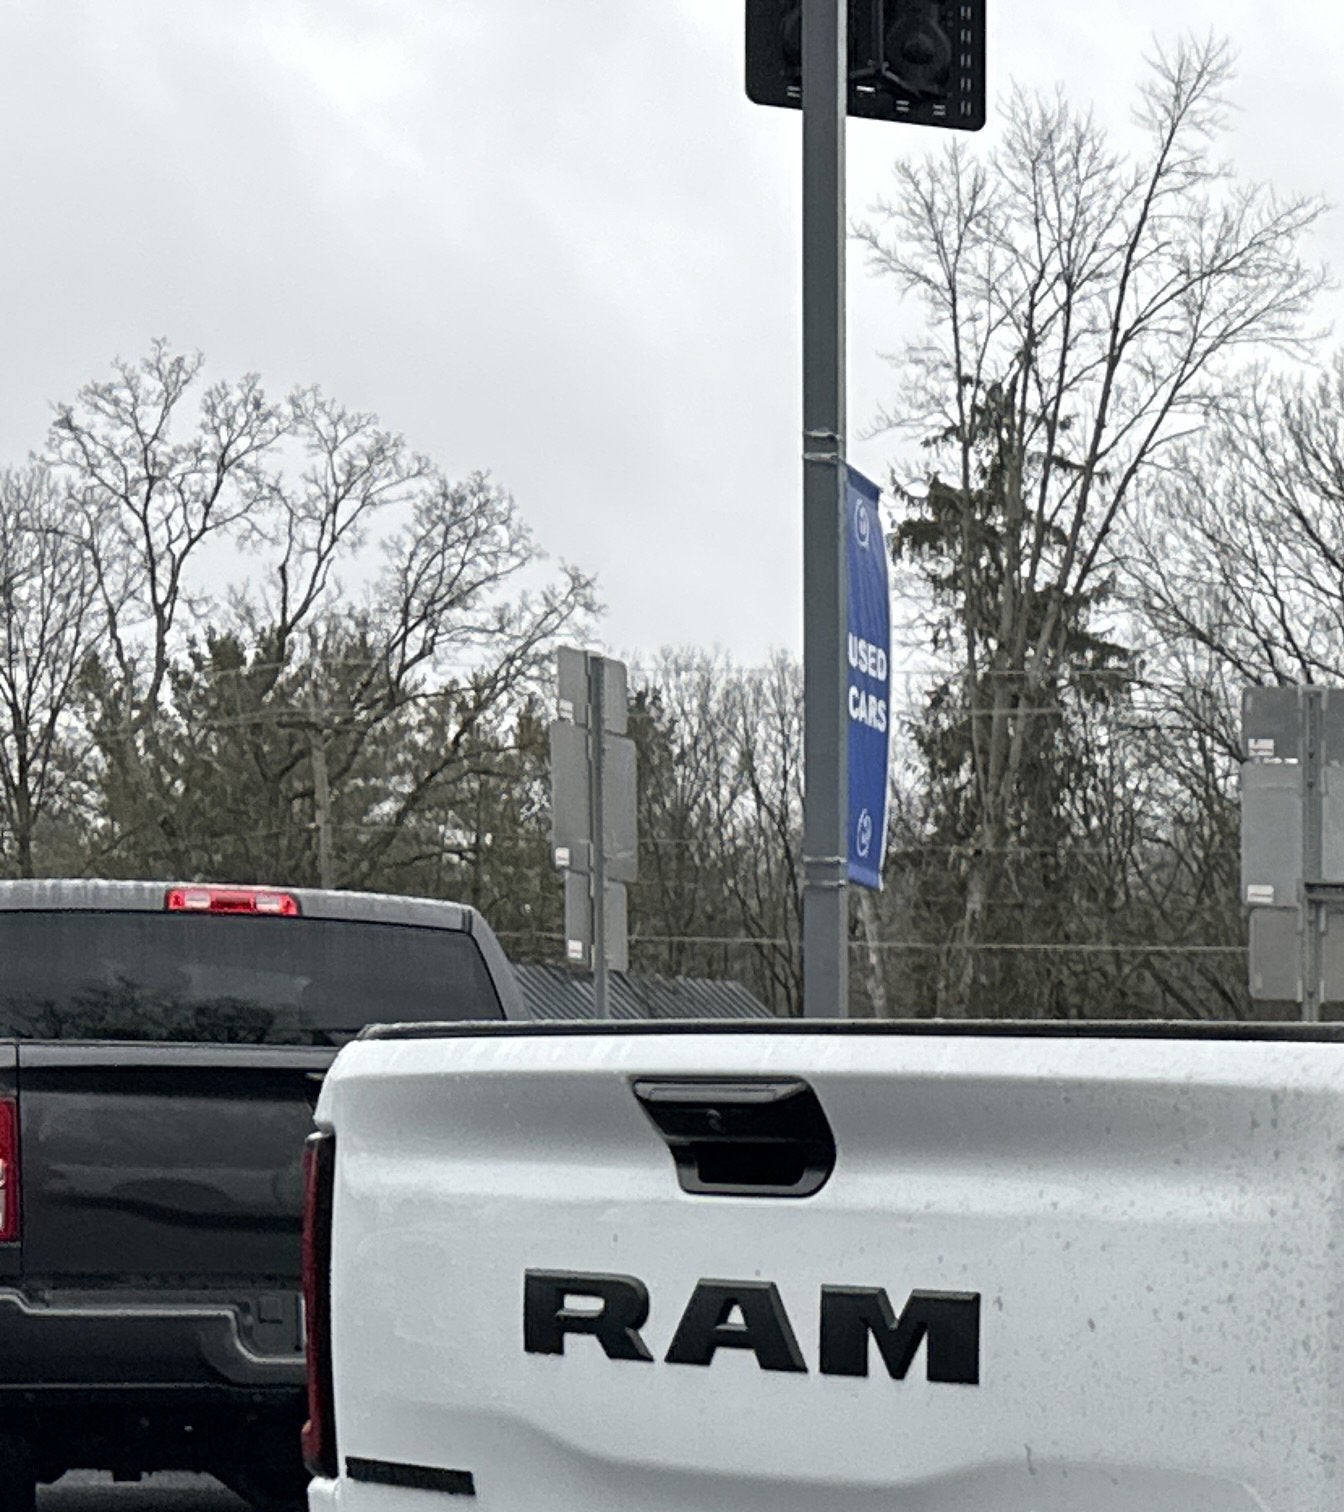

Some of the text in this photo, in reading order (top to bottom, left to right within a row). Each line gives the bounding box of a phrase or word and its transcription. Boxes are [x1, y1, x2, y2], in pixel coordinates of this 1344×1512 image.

[848, 632, 886, 682] USED
[848, 685, 886, 733] CARS
[524, 1267, 981, 1386] RAM
